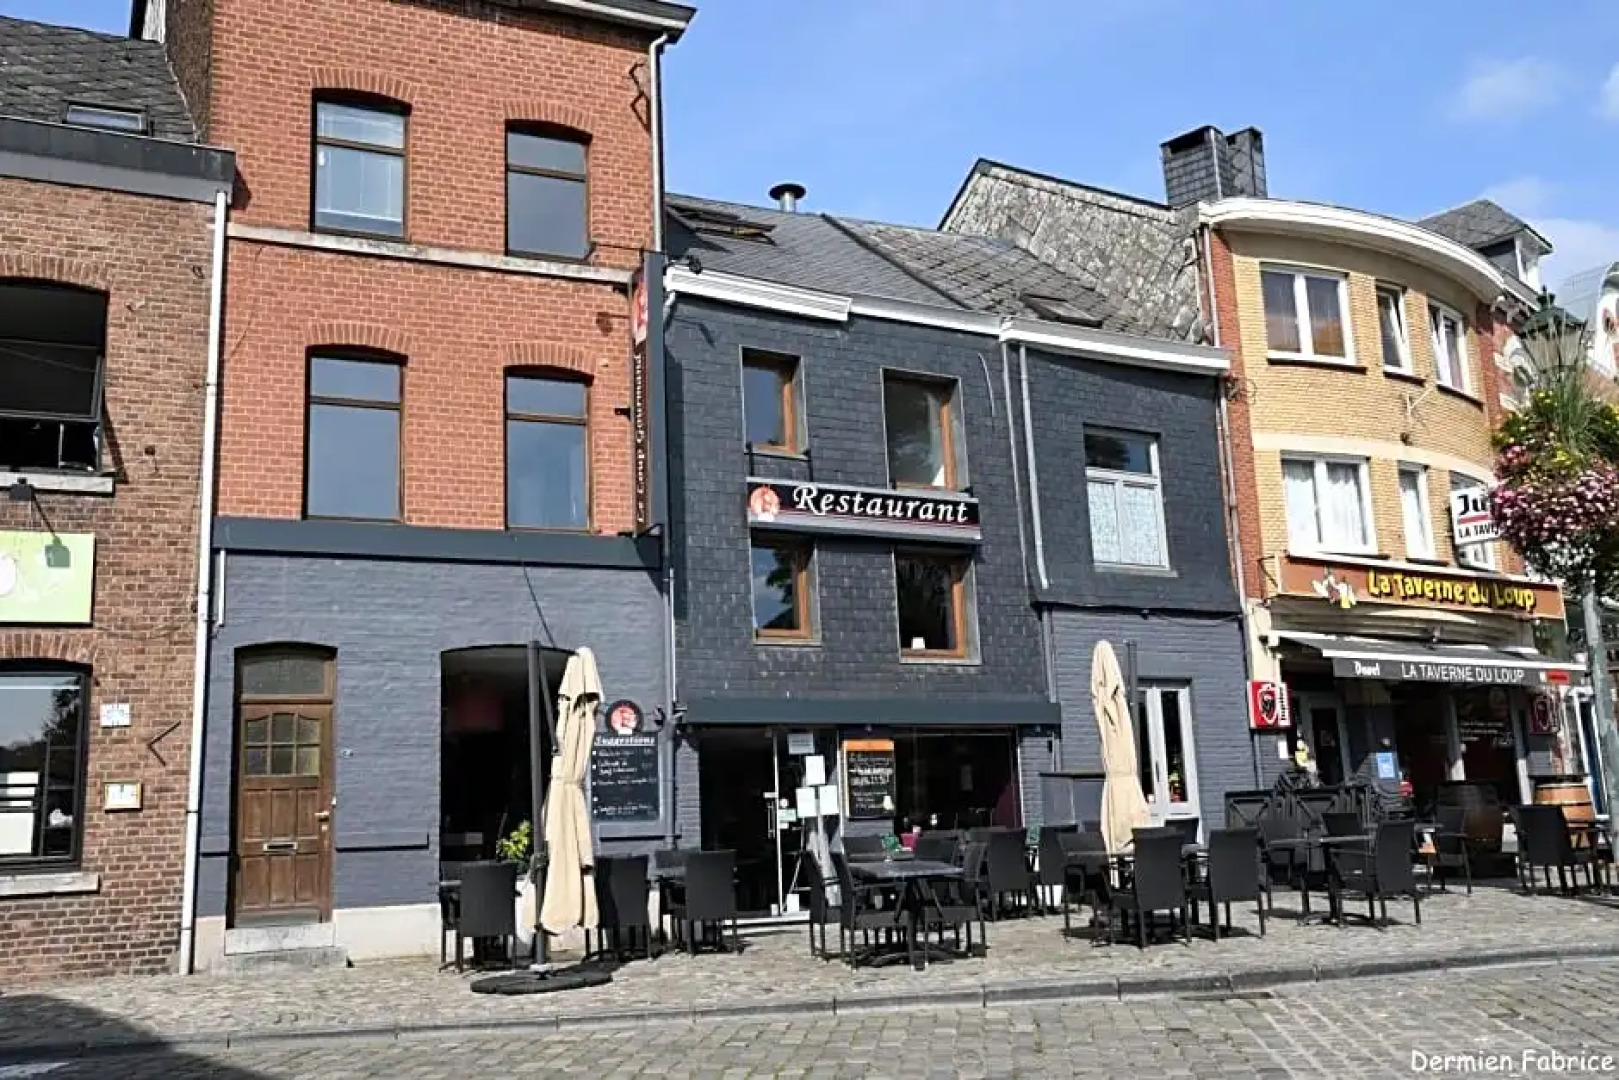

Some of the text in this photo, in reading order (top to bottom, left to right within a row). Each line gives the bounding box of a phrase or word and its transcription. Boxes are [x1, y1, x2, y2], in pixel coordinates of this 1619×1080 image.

[793, 485, 969, 523] Restaurant
[1457, 494, 1487, 515] Ju
[1459, 526, 1471, 538] LA
[1368, 569, 1534, 611] La Taverne du Loup
[1402, 662, 1525, 683] LA TAVERNE DU LOUP
